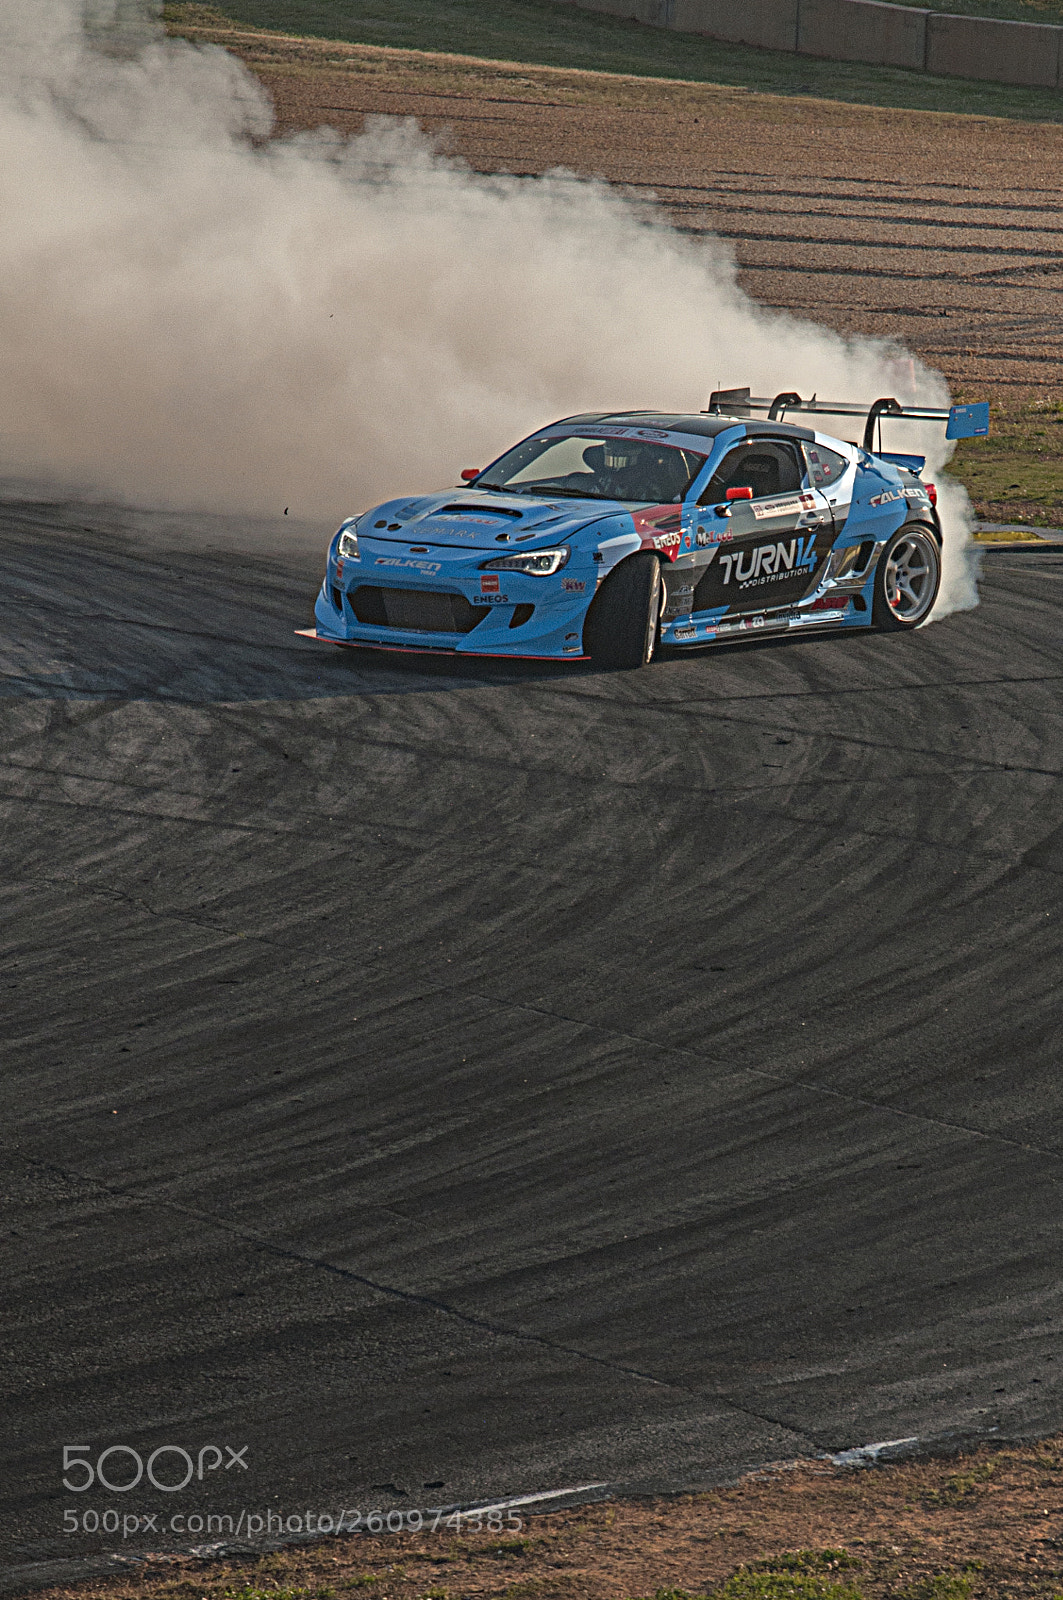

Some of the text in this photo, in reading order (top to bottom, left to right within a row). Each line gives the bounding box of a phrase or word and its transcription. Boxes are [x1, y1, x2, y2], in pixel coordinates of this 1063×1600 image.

[868, 488, 925, 508] FALKEN
[374, 557, 441, 571] FALKEN
[751, 567, 808, 587] DISTRIBUTION
[473, 594, 508, 604] ENEOS
